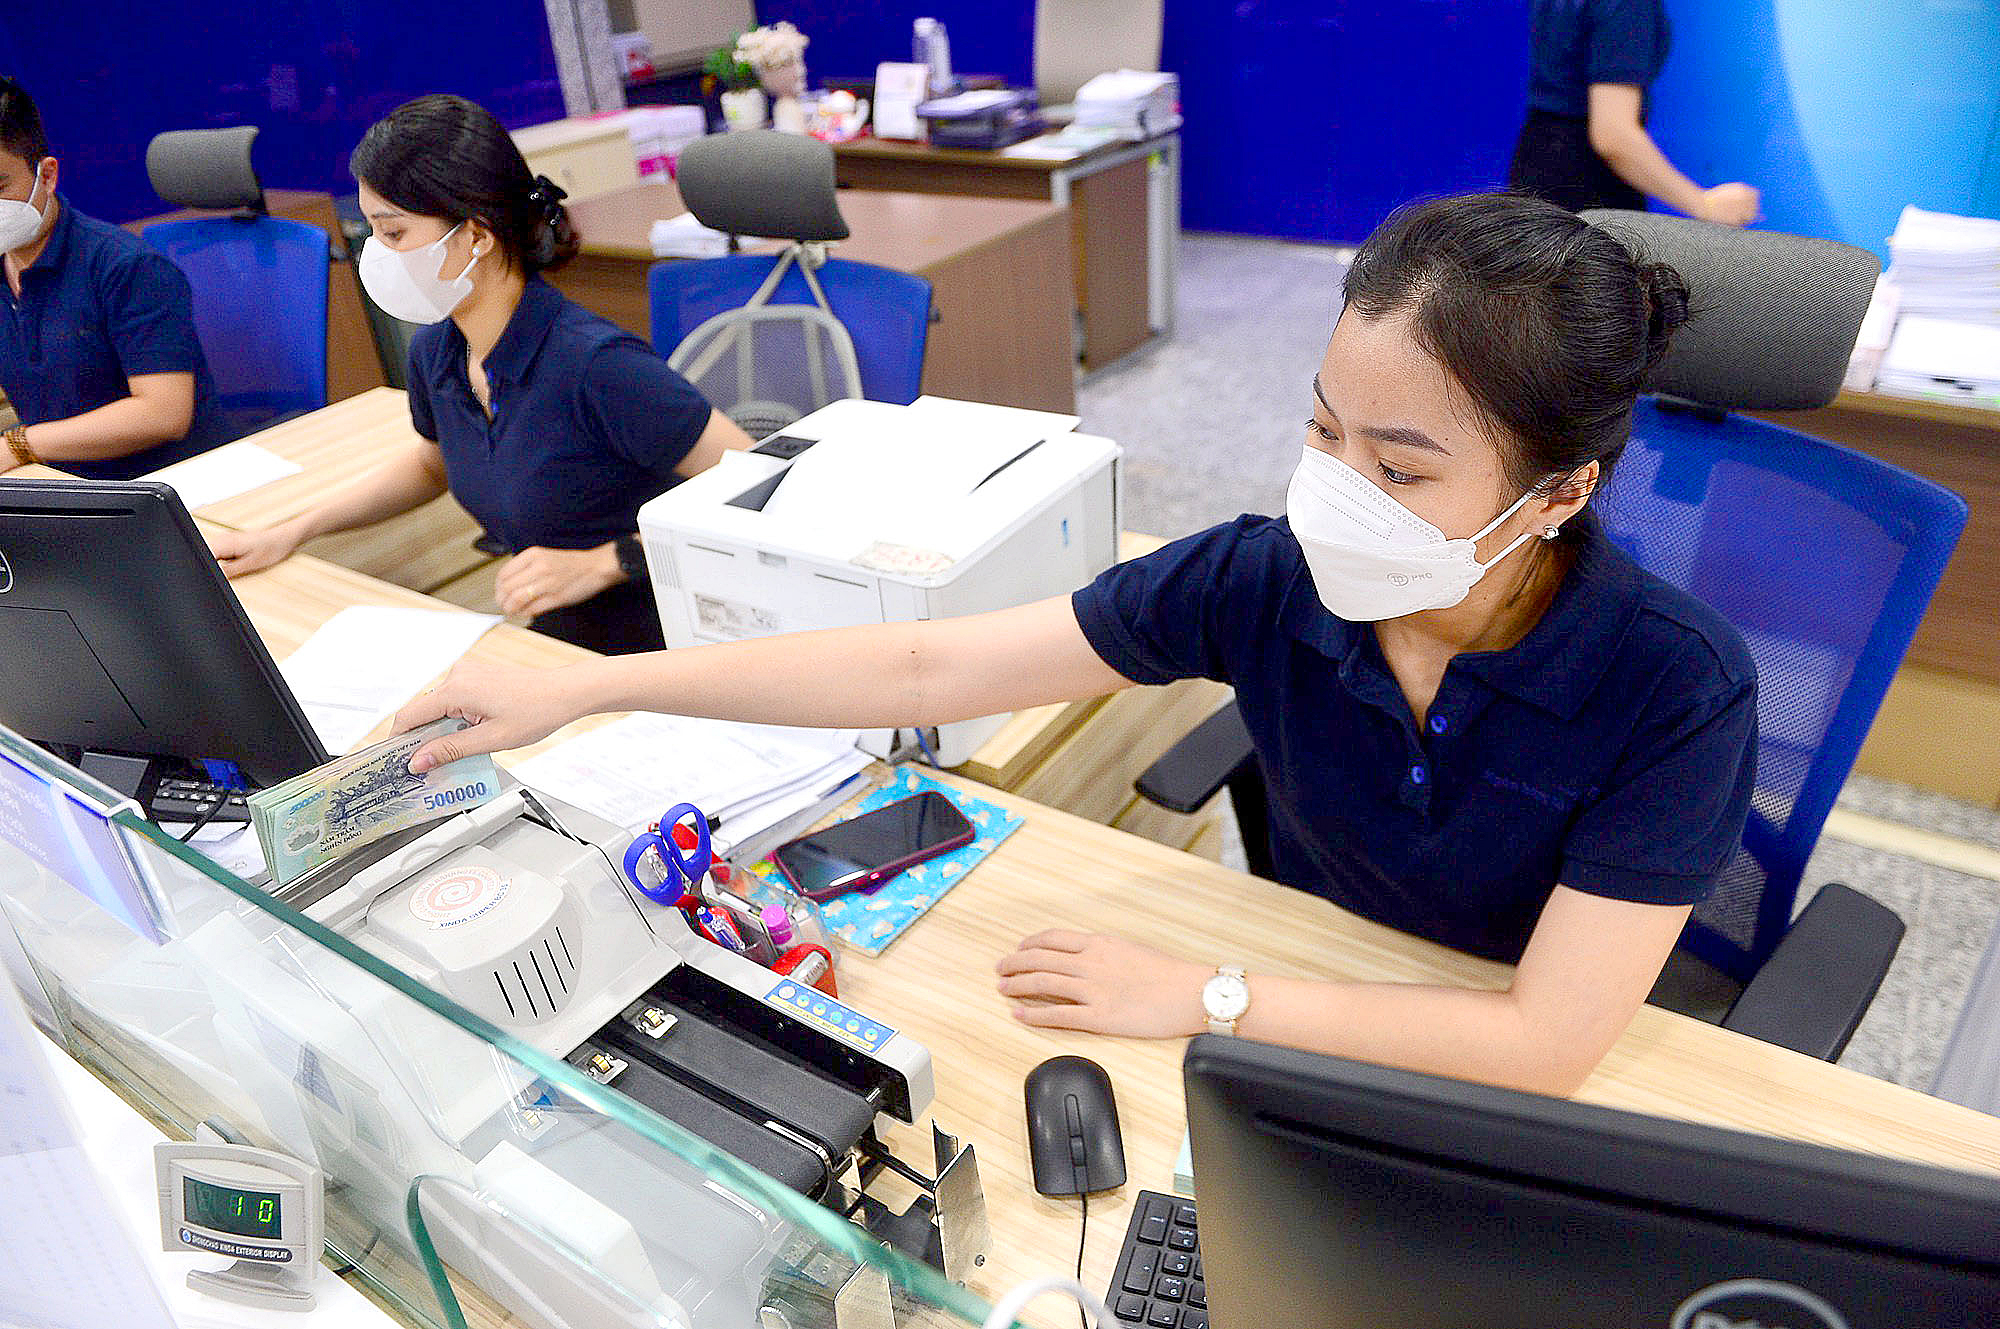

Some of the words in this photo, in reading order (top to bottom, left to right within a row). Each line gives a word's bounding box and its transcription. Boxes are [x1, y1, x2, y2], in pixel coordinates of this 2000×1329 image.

[424, 781, 488, 811] 500000
[236, 1246, 263, 1258] EXTERIOR
[263, 1249, 288, 1259] DISPLAY
